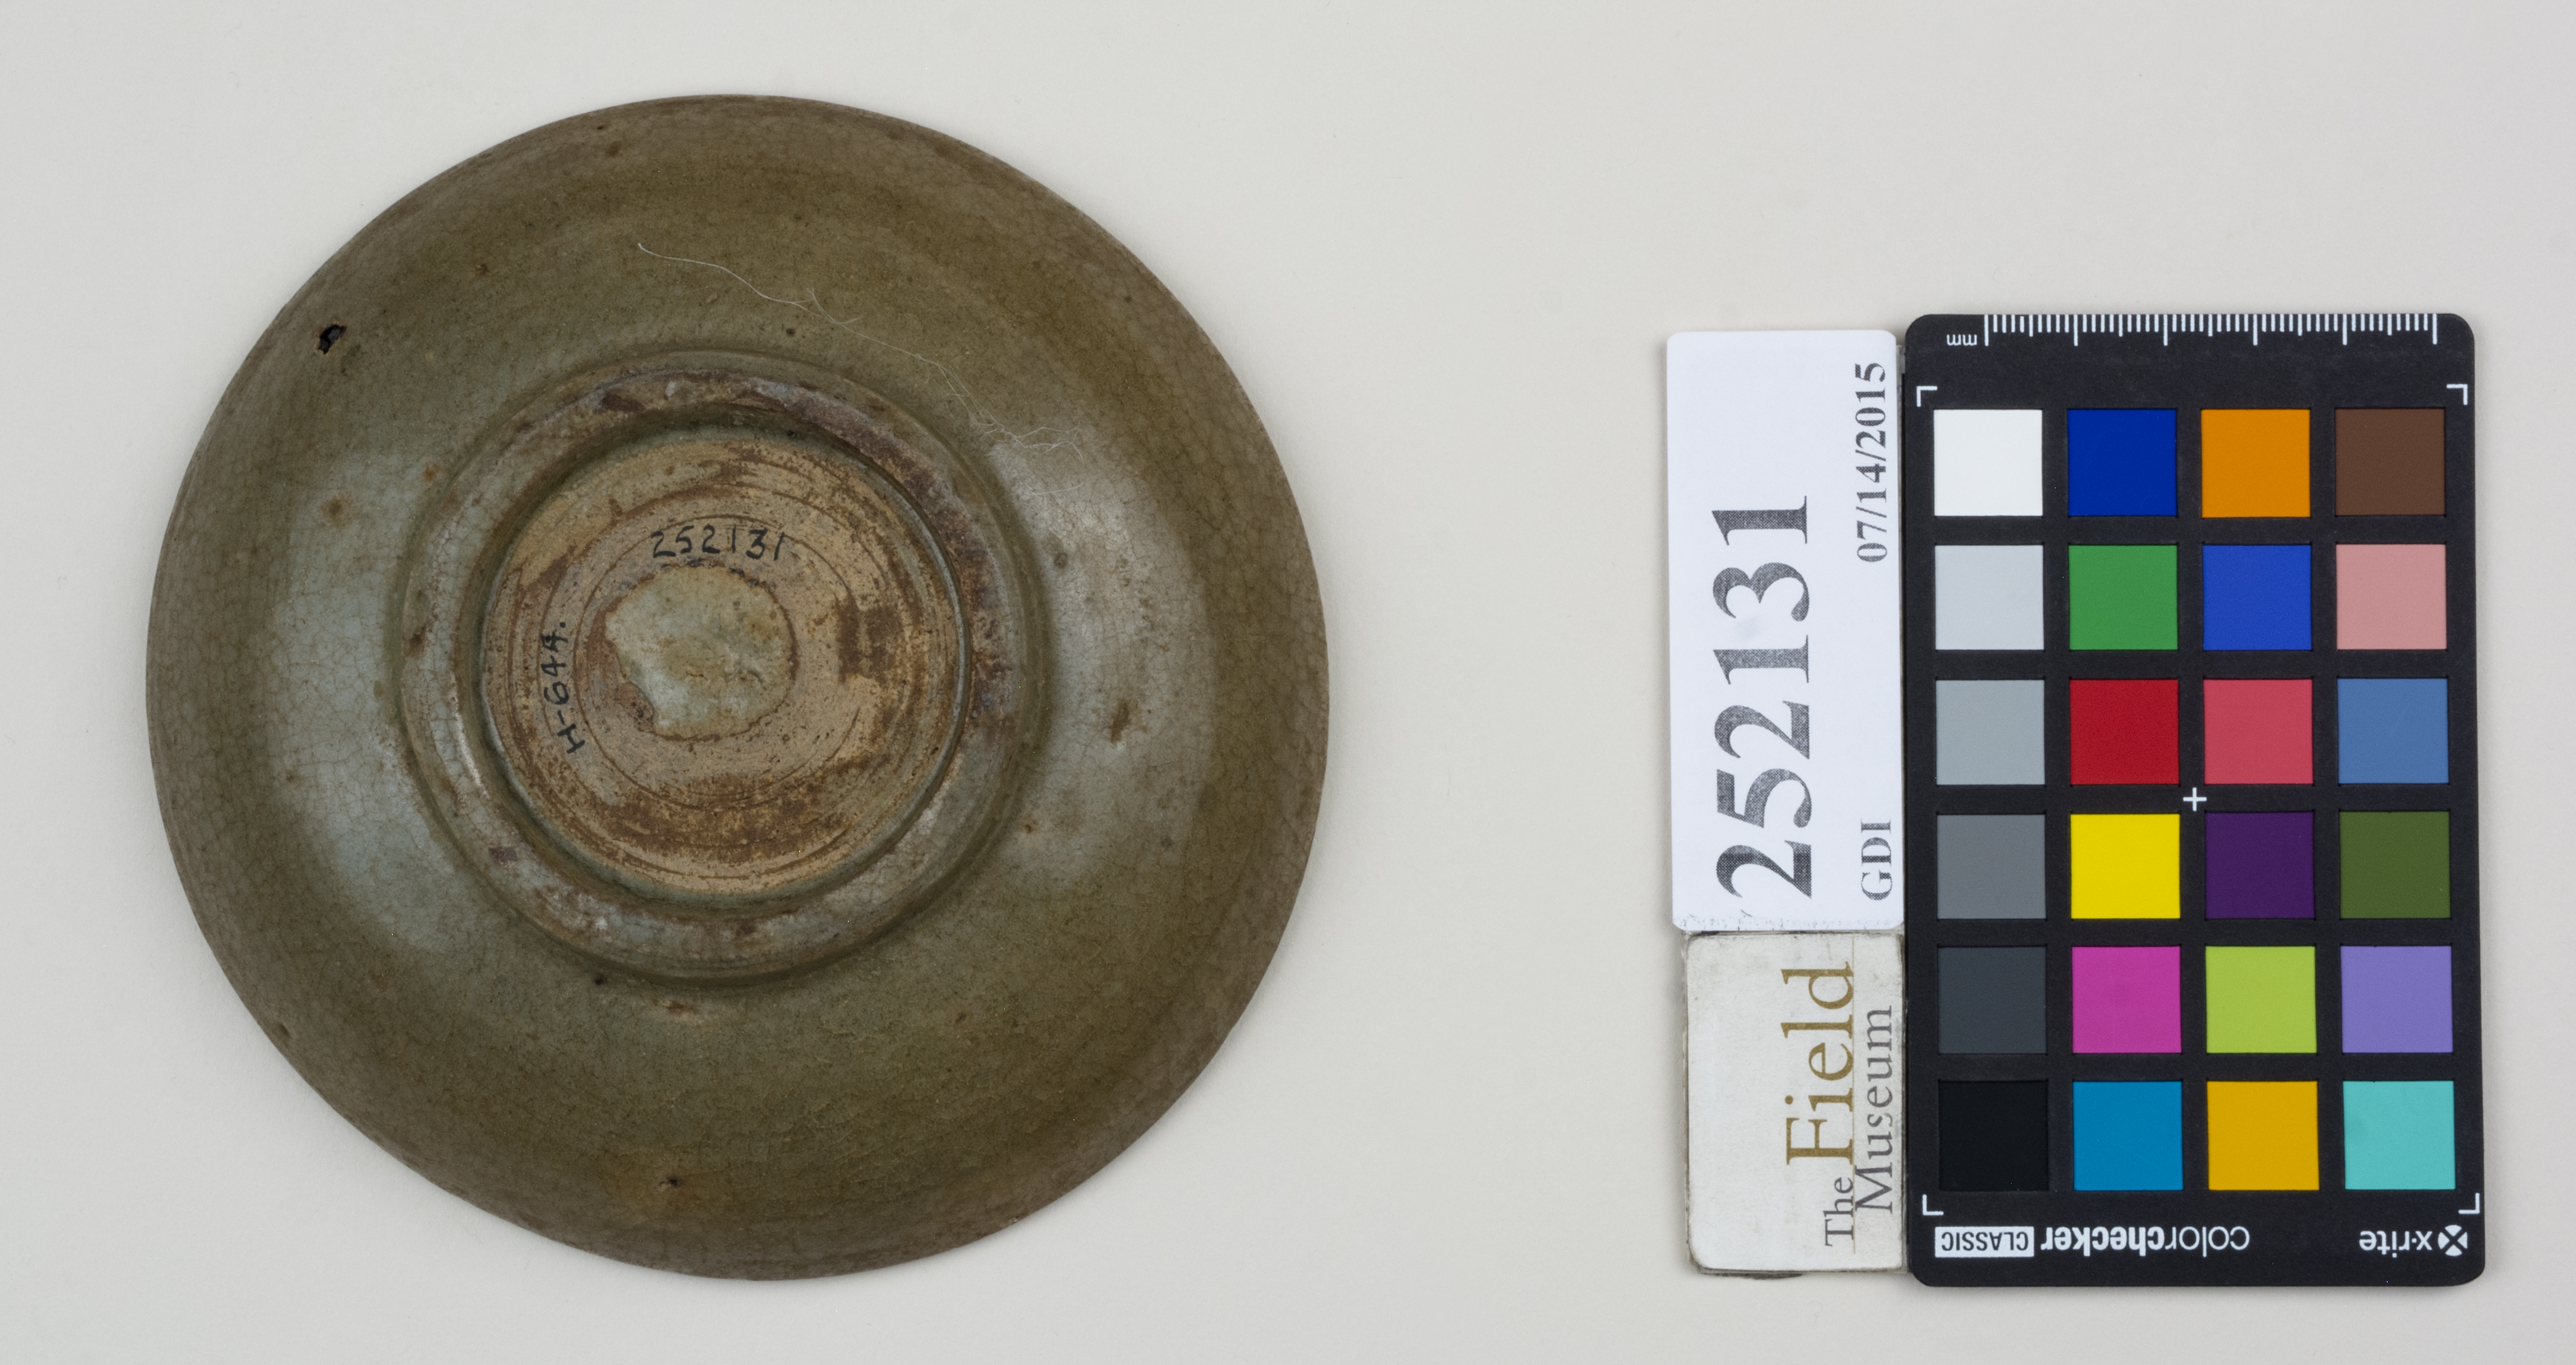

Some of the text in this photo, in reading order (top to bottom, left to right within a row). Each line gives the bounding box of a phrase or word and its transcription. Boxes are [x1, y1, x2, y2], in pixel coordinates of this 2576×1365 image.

[1946, 334, 1977, 346] mm
[1855, 362, 1888, 563] 07/14/2015
[651, 524, 785, 561] 252131
[1711, 495, 1812, 899] 252131
[1860, 819, 1893, 901] GDI
[1780, 961, 1854, 1247] The Field
[1854, 1005, 1893, 1214] Museum
[1941, 1226, 2251, 1257] colorchecker CLASSIC
